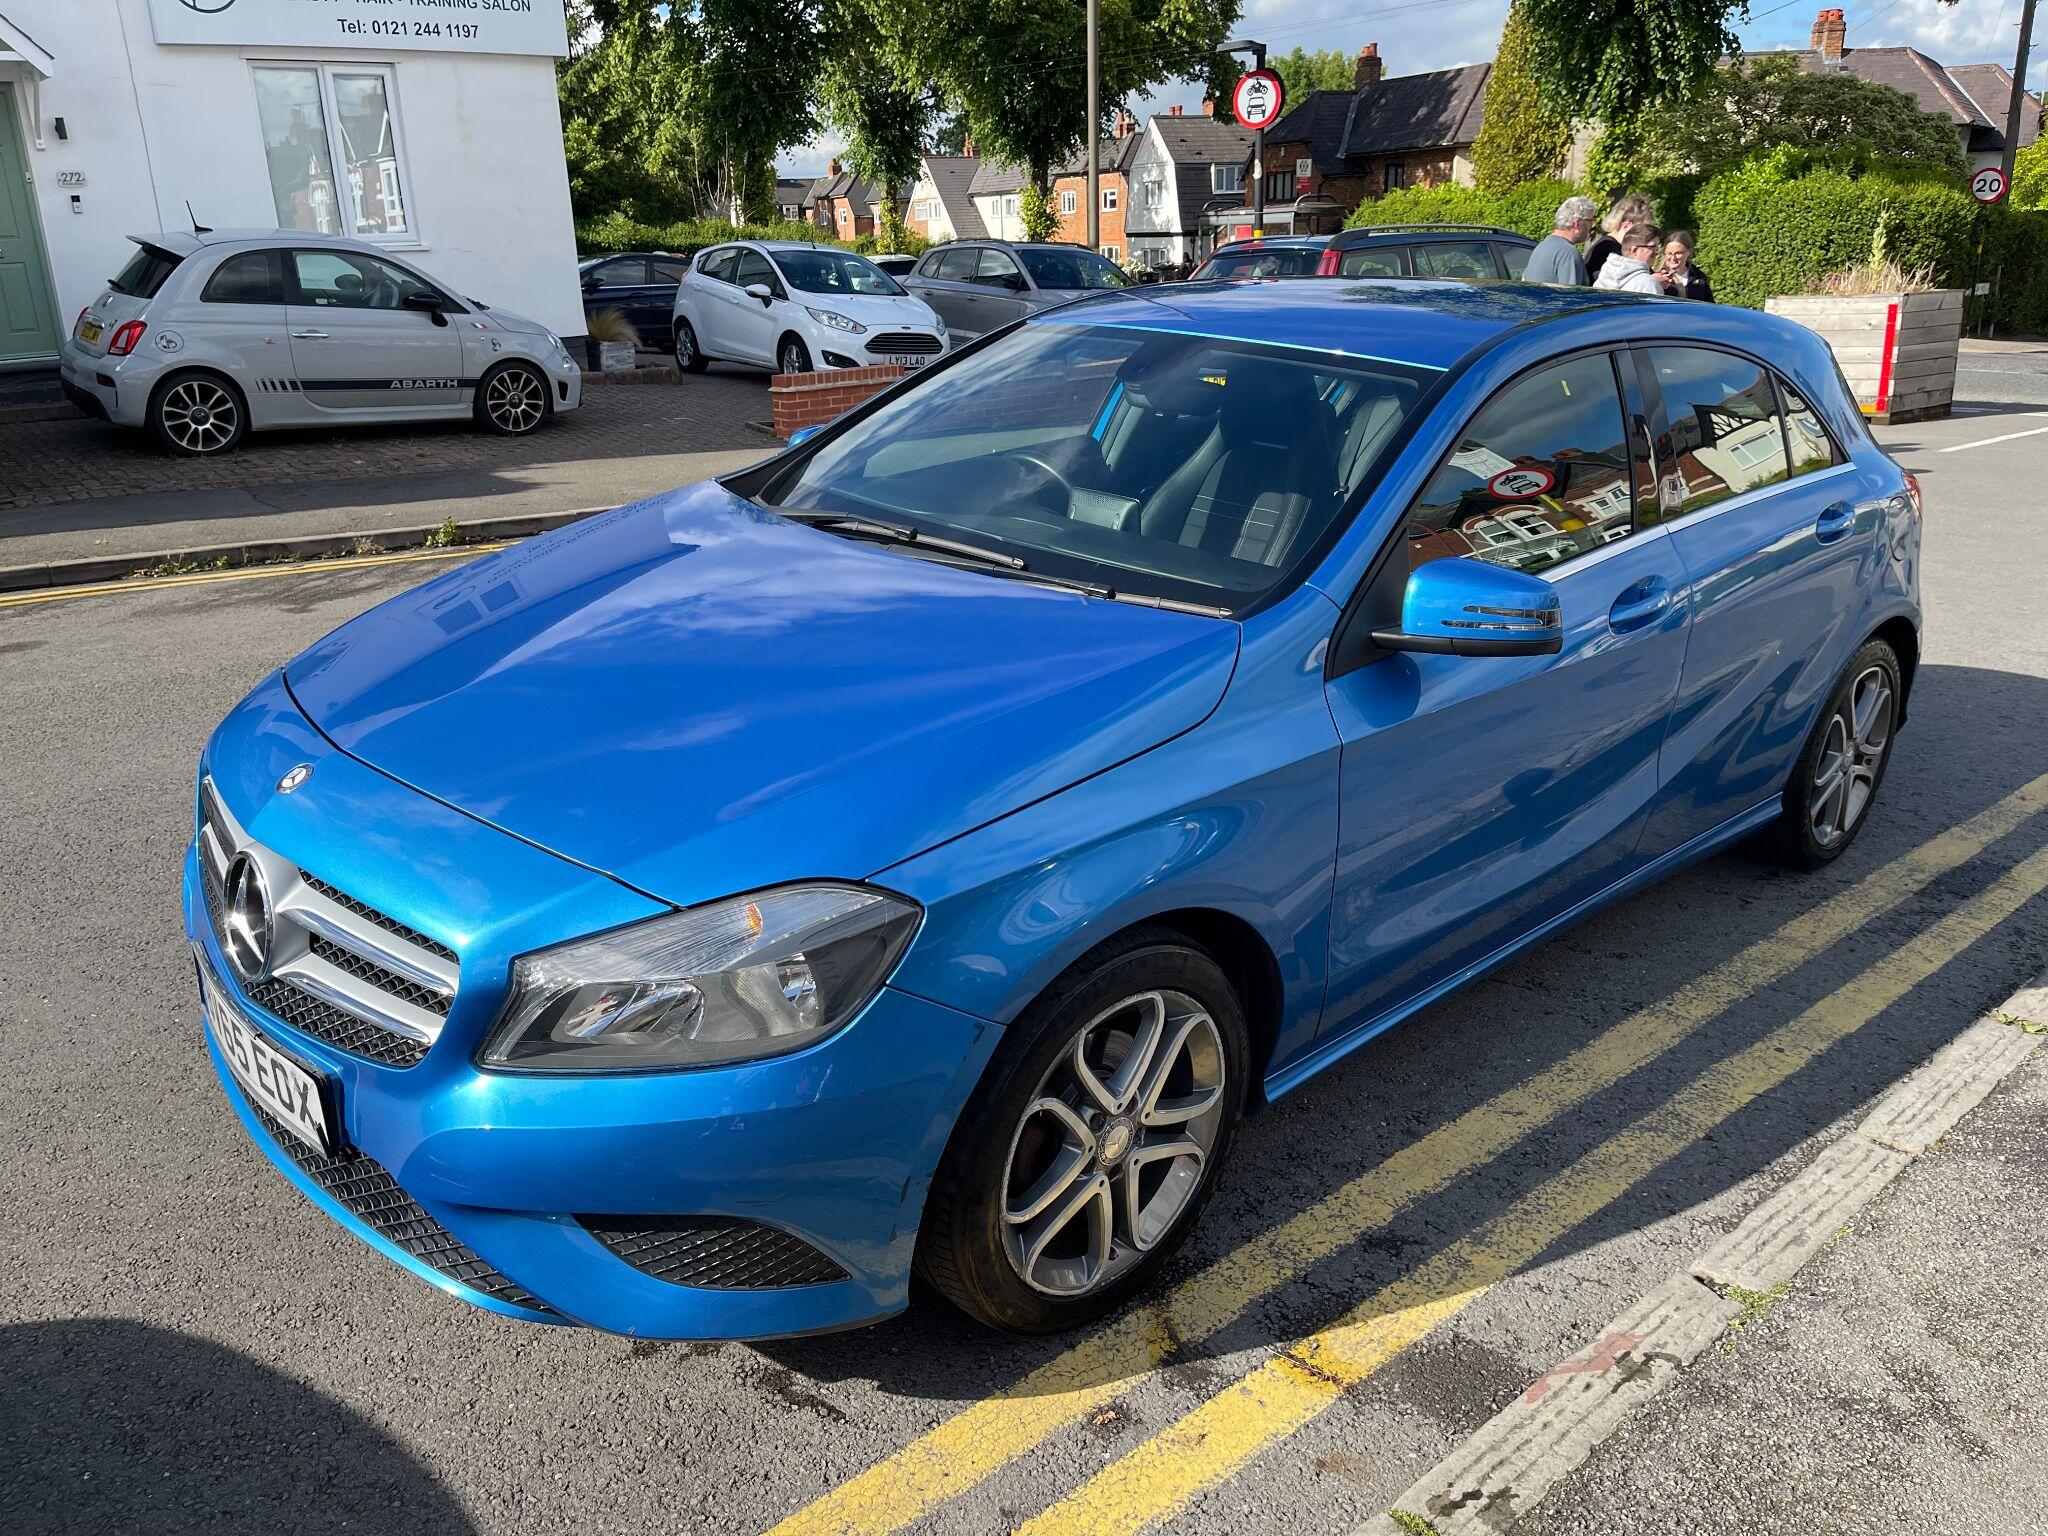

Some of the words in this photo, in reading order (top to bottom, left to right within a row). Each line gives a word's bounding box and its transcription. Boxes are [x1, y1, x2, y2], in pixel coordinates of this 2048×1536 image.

[482, 0, 531, 11] SALON
[337, 19, 367, 34] Tel:
[372, 20, 407, 35] 0121
[414, 22, 441, 37] 244
[446, 24, 479, 38] 1197
[61, 172, 81, 182] 272
[1976, 178, 2001, 192] 20
[889, 356, 908, 365] LY13
[390, 379, 458, 389] ABARTH
[206, 979, 250, 1074] 65
[251, 1040, 319, 1128] EOX
